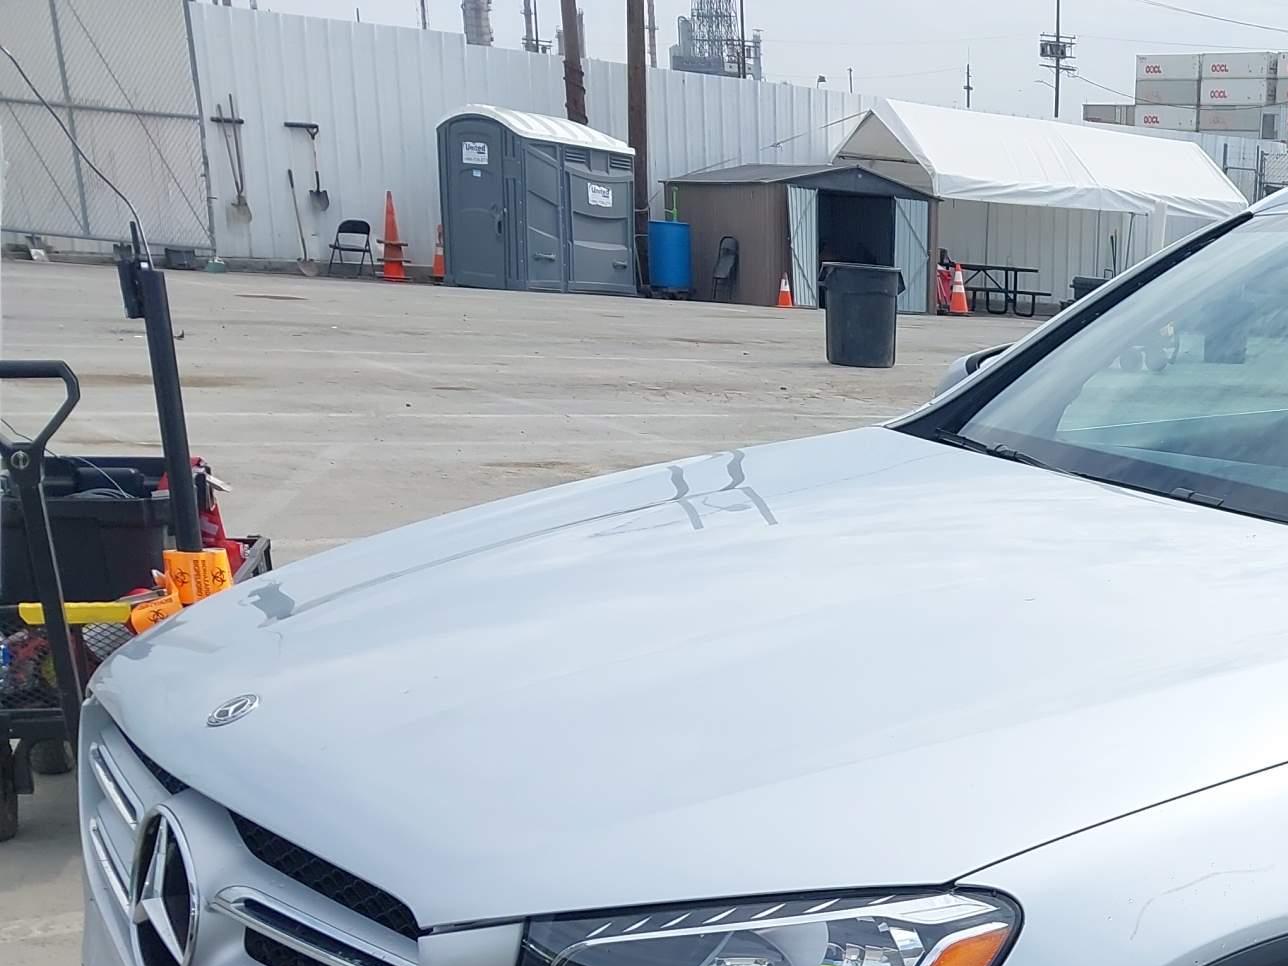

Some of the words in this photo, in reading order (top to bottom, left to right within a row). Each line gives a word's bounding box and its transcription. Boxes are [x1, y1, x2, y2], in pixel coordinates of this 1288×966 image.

[1145, 64, 1162, 74] OOCL
[1211, 63, 1229, 73] OOCL
[1210, 89, 1228, 98] OOCL
[1143, 115, 1160, 124] OOCL
